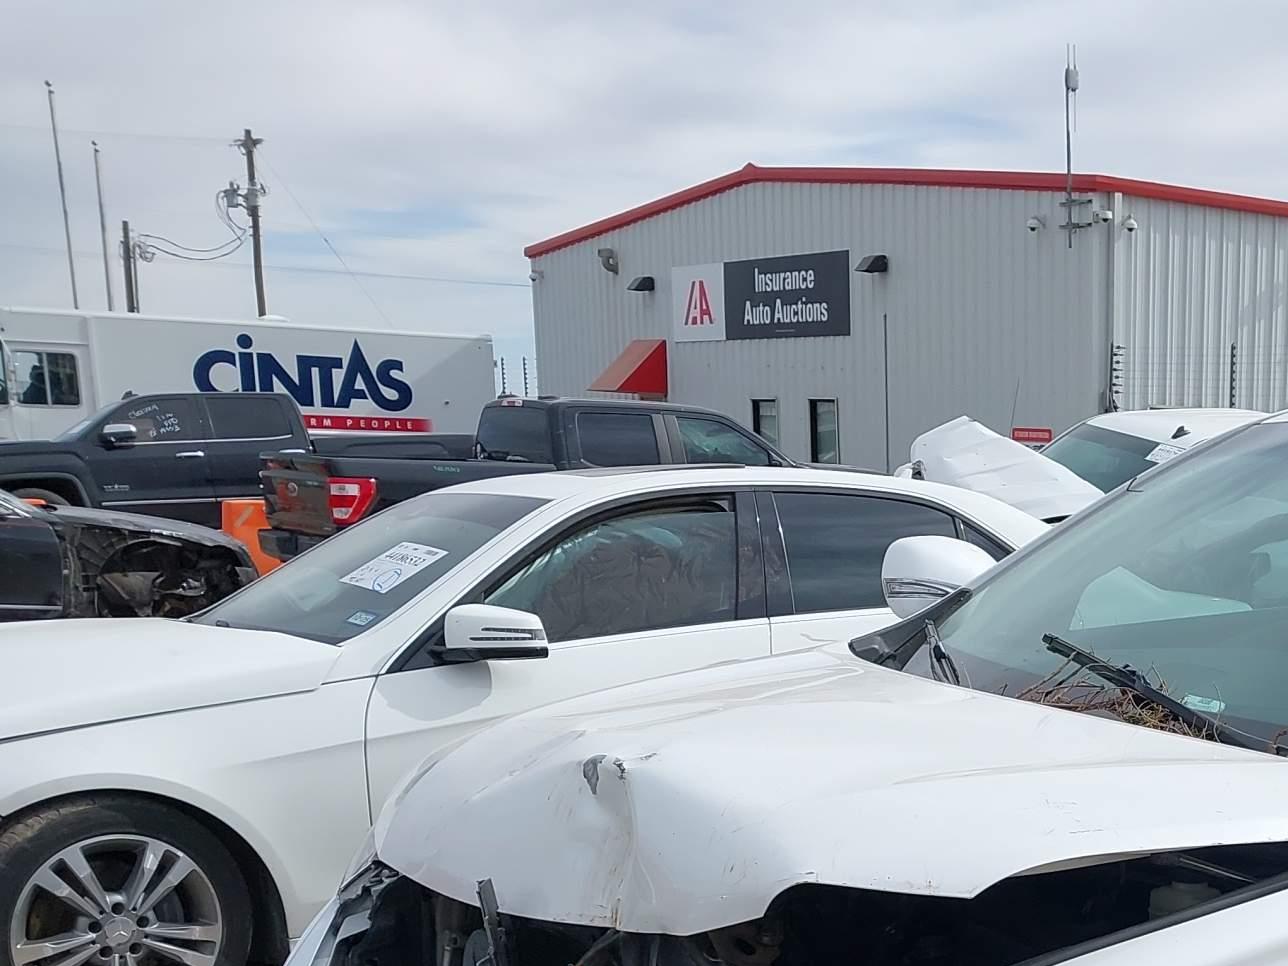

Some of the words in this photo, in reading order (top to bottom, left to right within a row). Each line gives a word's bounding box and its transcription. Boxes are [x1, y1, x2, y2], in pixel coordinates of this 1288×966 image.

[754, 268, 815, 293] Insurance
[744, 300, 771, 326] Auto
[774, 298, 828, 324] Auctions
[346, 418, 413, 429] PEOPLE
